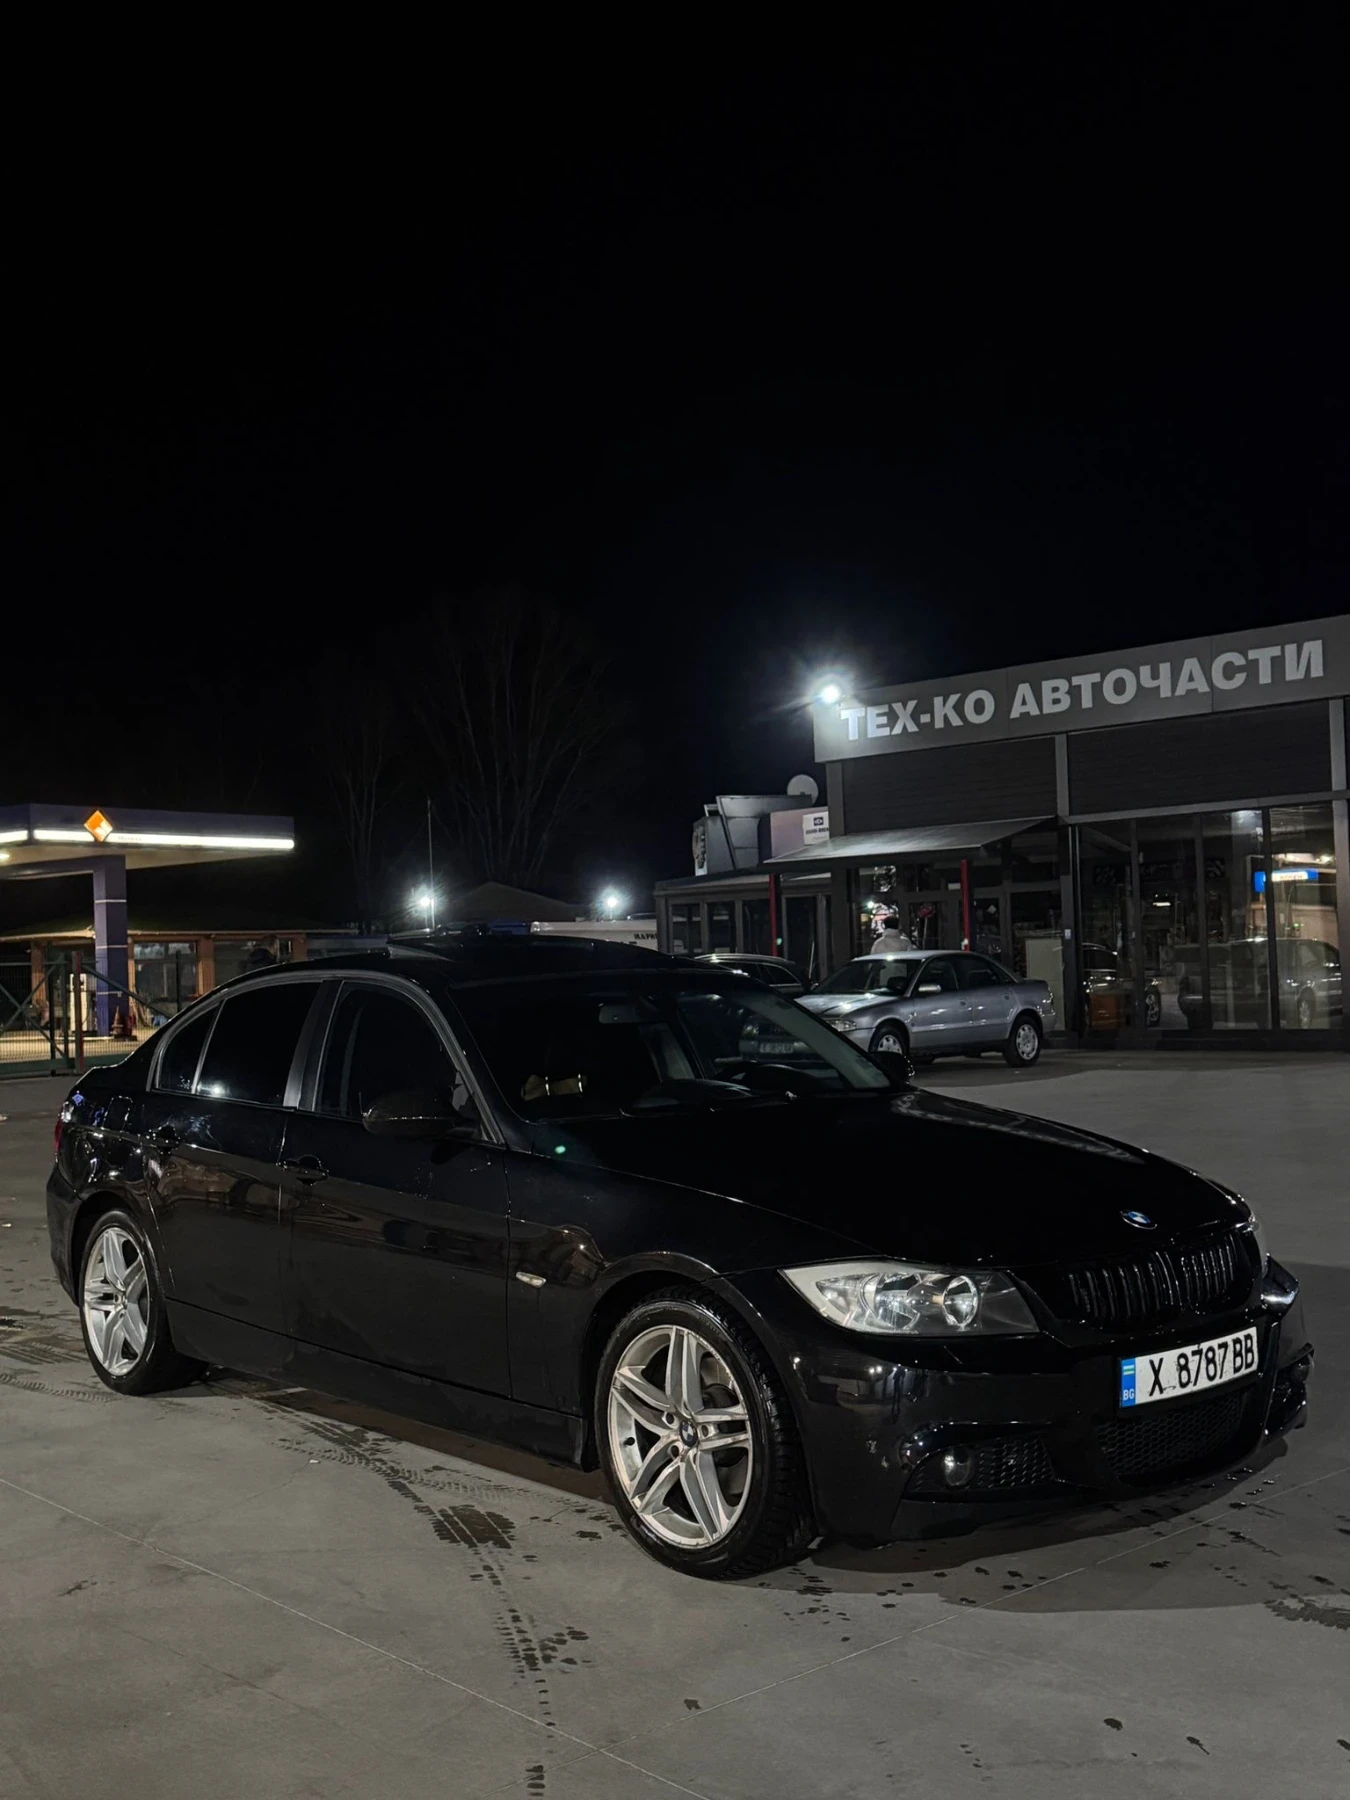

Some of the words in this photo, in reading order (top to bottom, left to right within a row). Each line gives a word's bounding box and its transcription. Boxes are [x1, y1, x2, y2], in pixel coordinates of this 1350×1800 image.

[840, 689, 996, 741] ТЕХ-КО
[1009, 639, 1325, 719] АВТОЧАСТИ
[1122, 1389, 1135, 1401] BG
